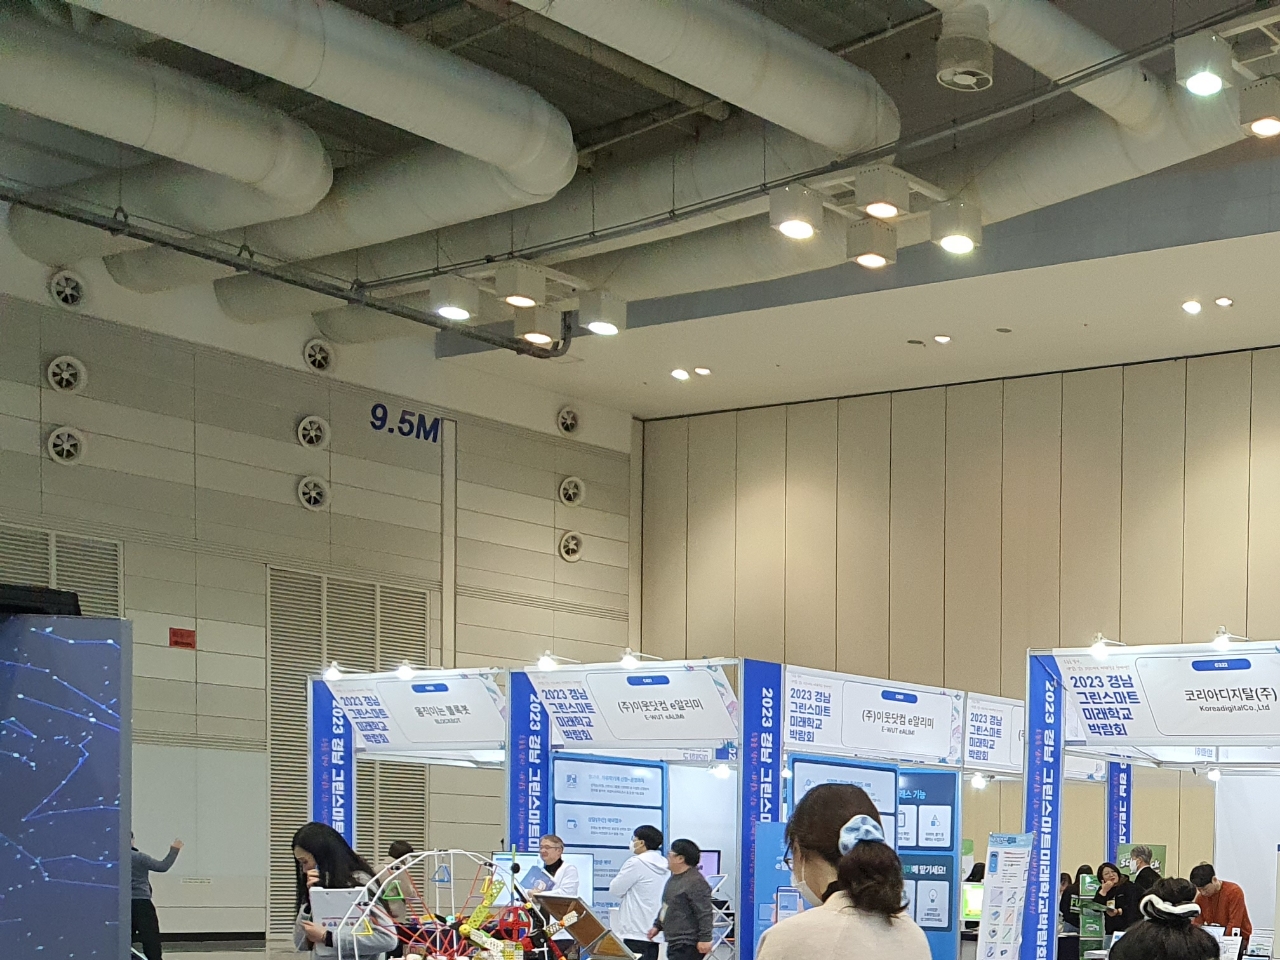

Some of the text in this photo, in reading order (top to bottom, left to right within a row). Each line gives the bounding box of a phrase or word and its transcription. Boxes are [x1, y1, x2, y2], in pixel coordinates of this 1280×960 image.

[370, 403, 440, 443] 9.5M
[1070, 675, 1134, 688] 2023 경남
[541, 688, 589, 700] 2023 경남
[790, 688, 832, 704] 2023 경남
[1076, 691, 1141, 704] 그린스마트
[1185, 687, 1278, 703] 코리아디지탈(주)
[340, 695, 381, 707] 2023 경남
[669, 698, 704, 711] e알리미
[762, 688, 773, 727] 2023
[1045, 680, 1055, 724] 2023
[348, 708, 389, 719] 그린스마트
[414, 705, 446, 718] 움직이는
[529, 693, 541, 731] 2023
[549, 702, 597, 714] 그린스마트
[790, 702, 832, 718] 그린스마트
[1084, 707, 1134, 720] 미래학교
[332, 699, 345, 734] 2023
[556, 716, 594, 728] 미래학교
[908, 716, 935, 729] e알리미
[970, 713, 1003, 727] 2023 경남
[356, 721, 389, 732] 미래학교
[789, 717, 823, 730] 미래학교
[1088, 723, 1128, 736] 박람회
[562, 730, 593, 741] 박람회
[789, 730, 814, 743] 박람회
[969, 725, 1002, 738] 그린스마트
[362, 733, 390, 744] 박람회
[969, 737, 996, 750] 미래학교
[331, 738, 345, 765] 경남
[528, 735, 541, 764] 경남
[760, 732, 773, 763] 경남
[1043, 729, 1054, 763] 경남
[968, 749, 989, 761] 박람회
[1120, 773, 1127, 797] 경남
